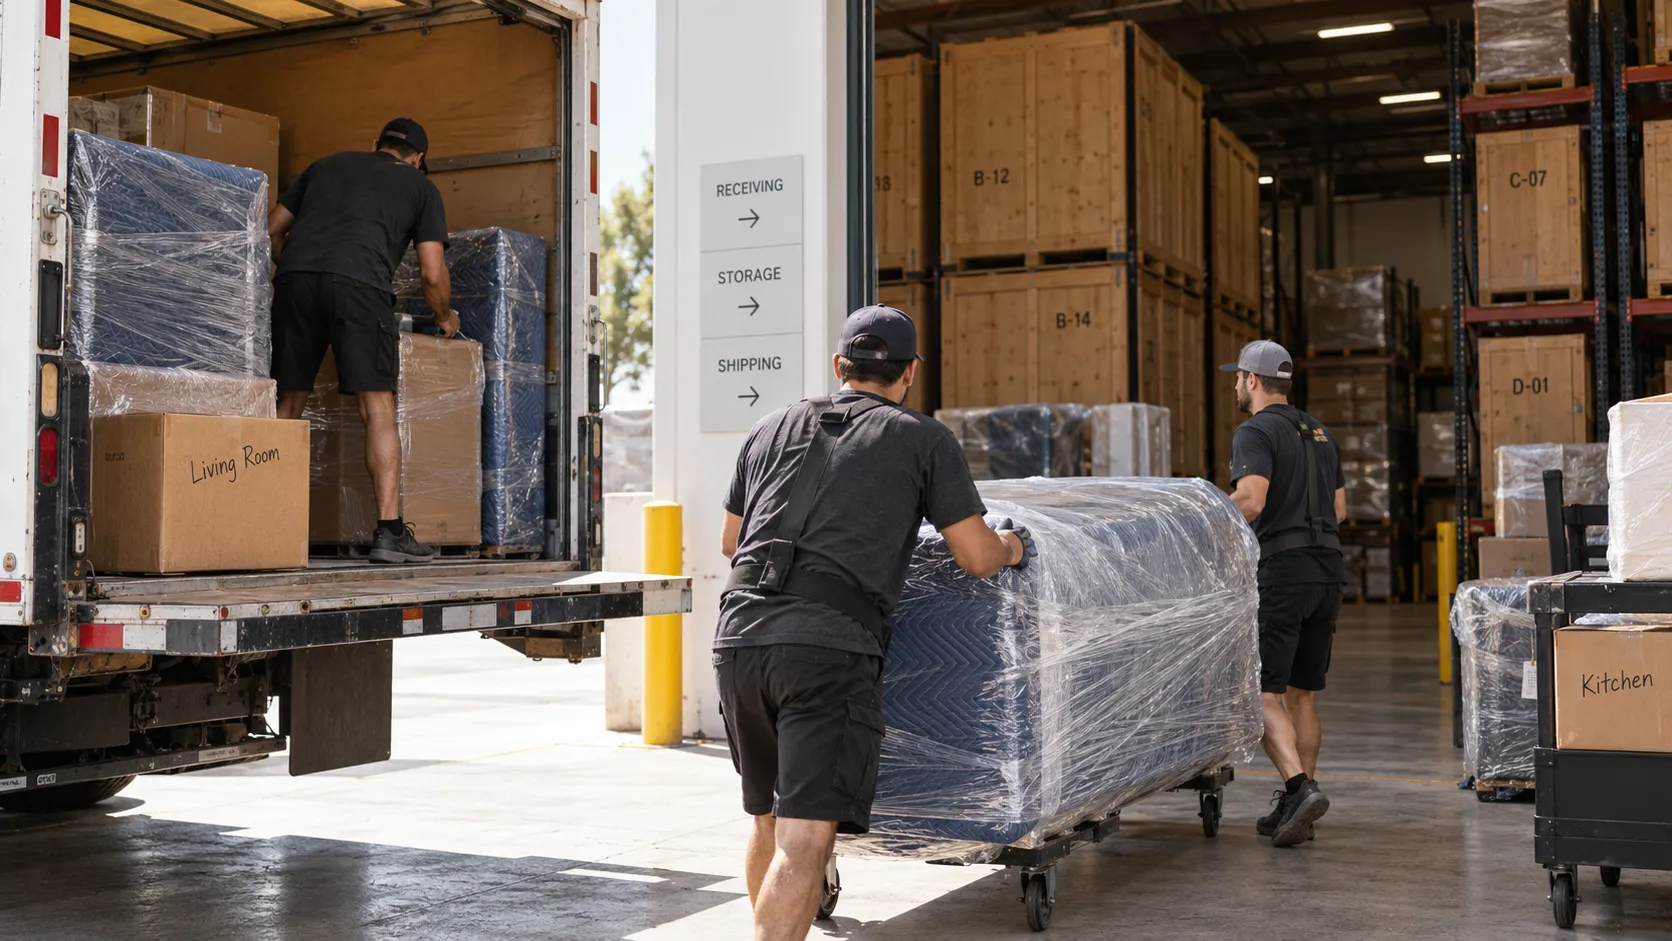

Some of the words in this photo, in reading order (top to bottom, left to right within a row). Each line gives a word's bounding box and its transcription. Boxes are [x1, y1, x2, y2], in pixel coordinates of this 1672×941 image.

[973, 168, 1010, 187] B-12
[1509, 169, 1547, 189] C-07
[716, 178, 784, 198] RECEIVING
[717, 266, 782, 285] STORAGE
[1056, 311, 1091, 330] B-14
[718, 356, 782, 373] SHIPPING
[1512, 376, 1548, 396] D-01
[190, 457, 237, 484] Living
[242, 444, 280, 468] Room
[1581, 669, 1654, 698] Kitchen
